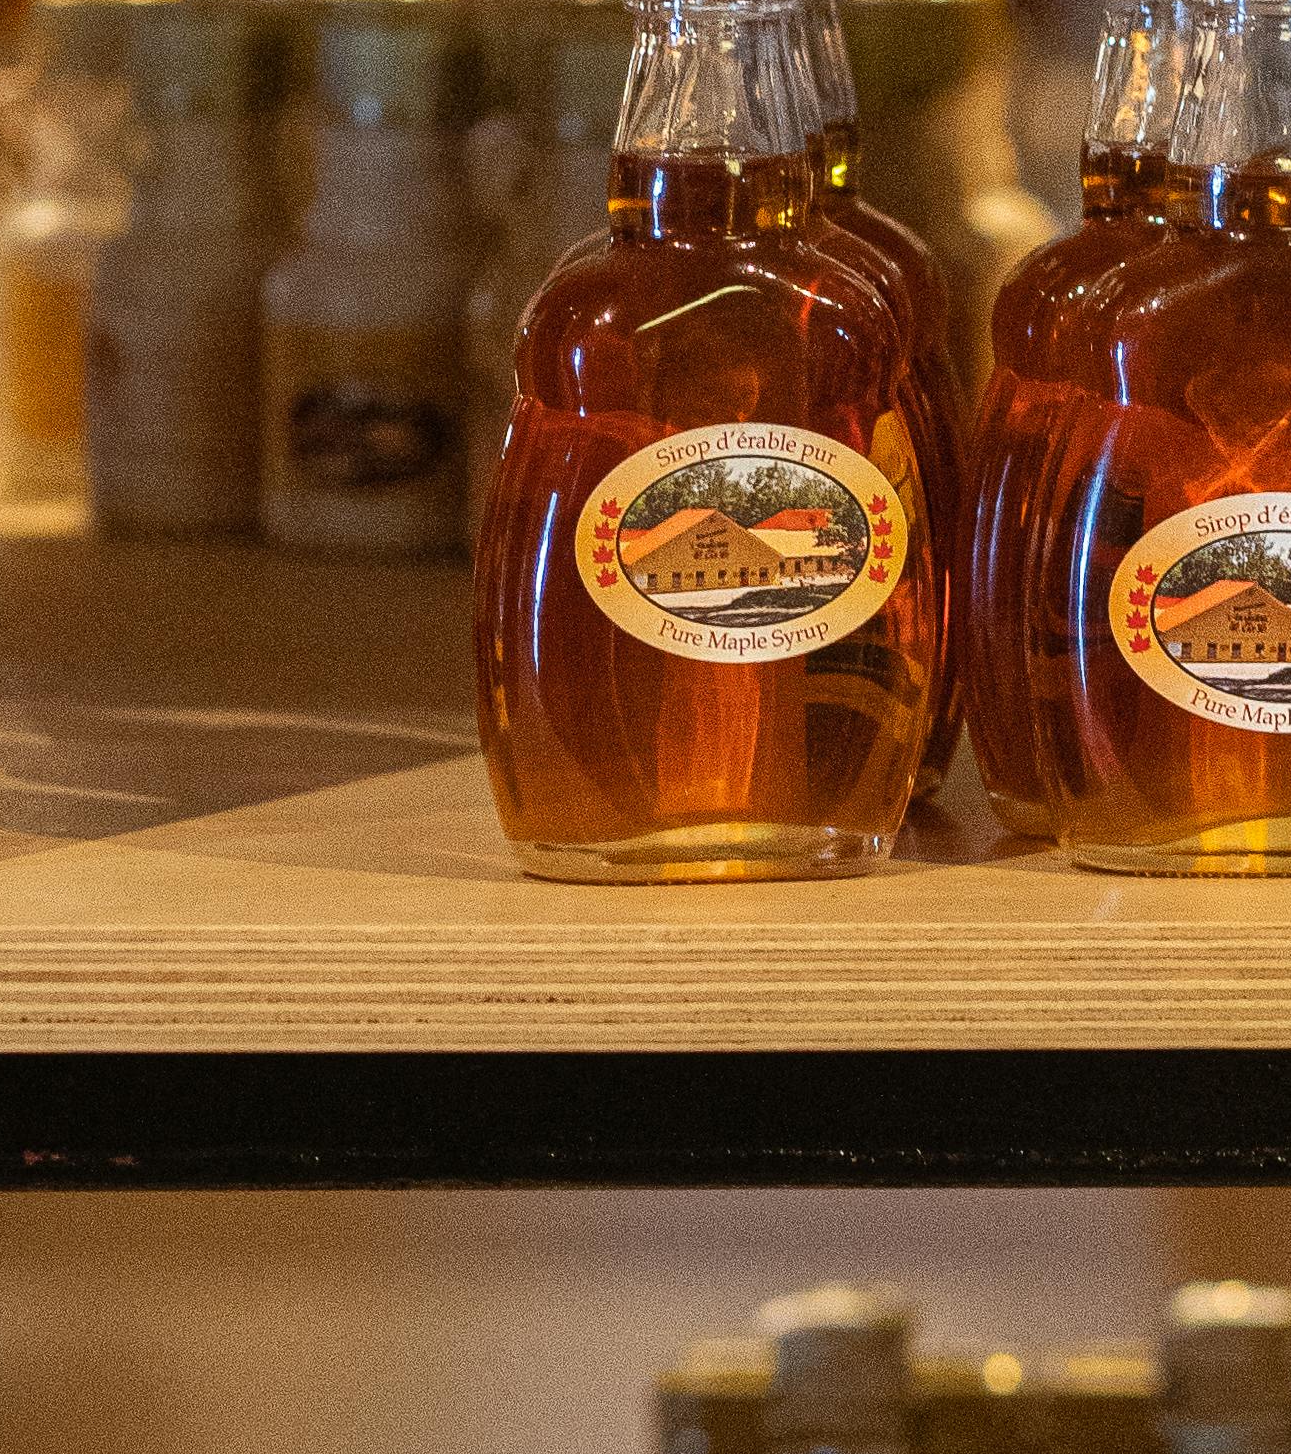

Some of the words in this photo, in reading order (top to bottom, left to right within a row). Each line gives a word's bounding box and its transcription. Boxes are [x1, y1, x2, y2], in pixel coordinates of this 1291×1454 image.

[656, 438, 711, 468] Sirop
[716, 431, 797, 453] d'érable
[800, 442, 837, 468] pur
[1194, 511, 1252, 539] Sirop
[659, 619, 704, 647] Pure
[707, 631, 768, 655] Maple
[770, 619, 830, 649] Syrup
[1190, 688, 1238, 719] Pure
